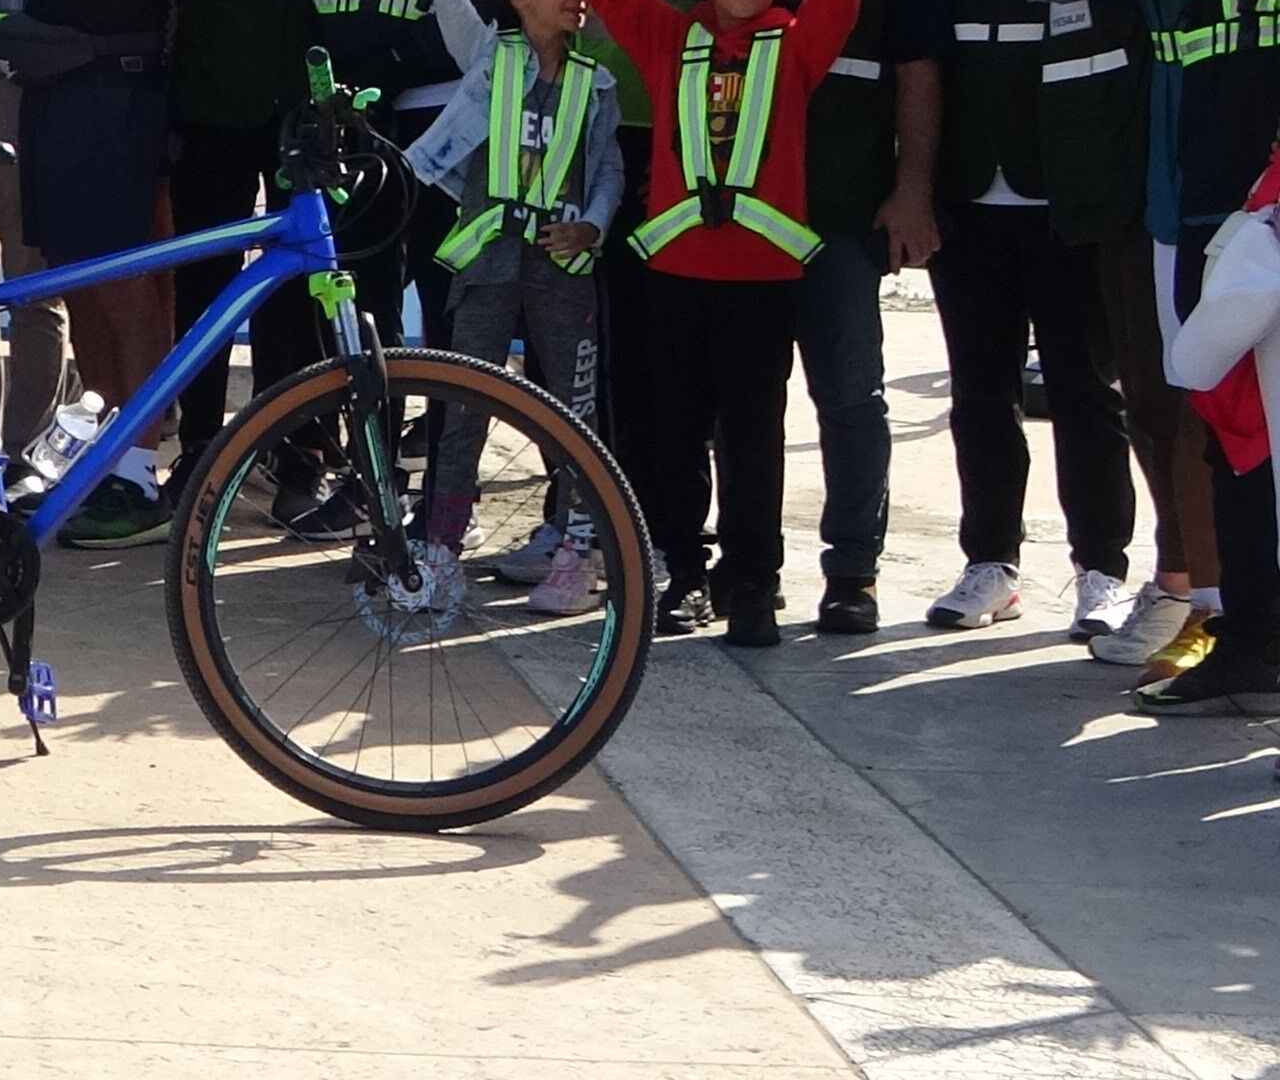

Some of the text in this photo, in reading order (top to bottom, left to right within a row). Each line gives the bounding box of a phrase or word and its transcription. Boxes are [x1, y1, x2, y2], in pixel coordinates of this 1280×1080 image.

[571, 338, 598, 418] SLEEP
[186, 481, 214, 587] CST JET
